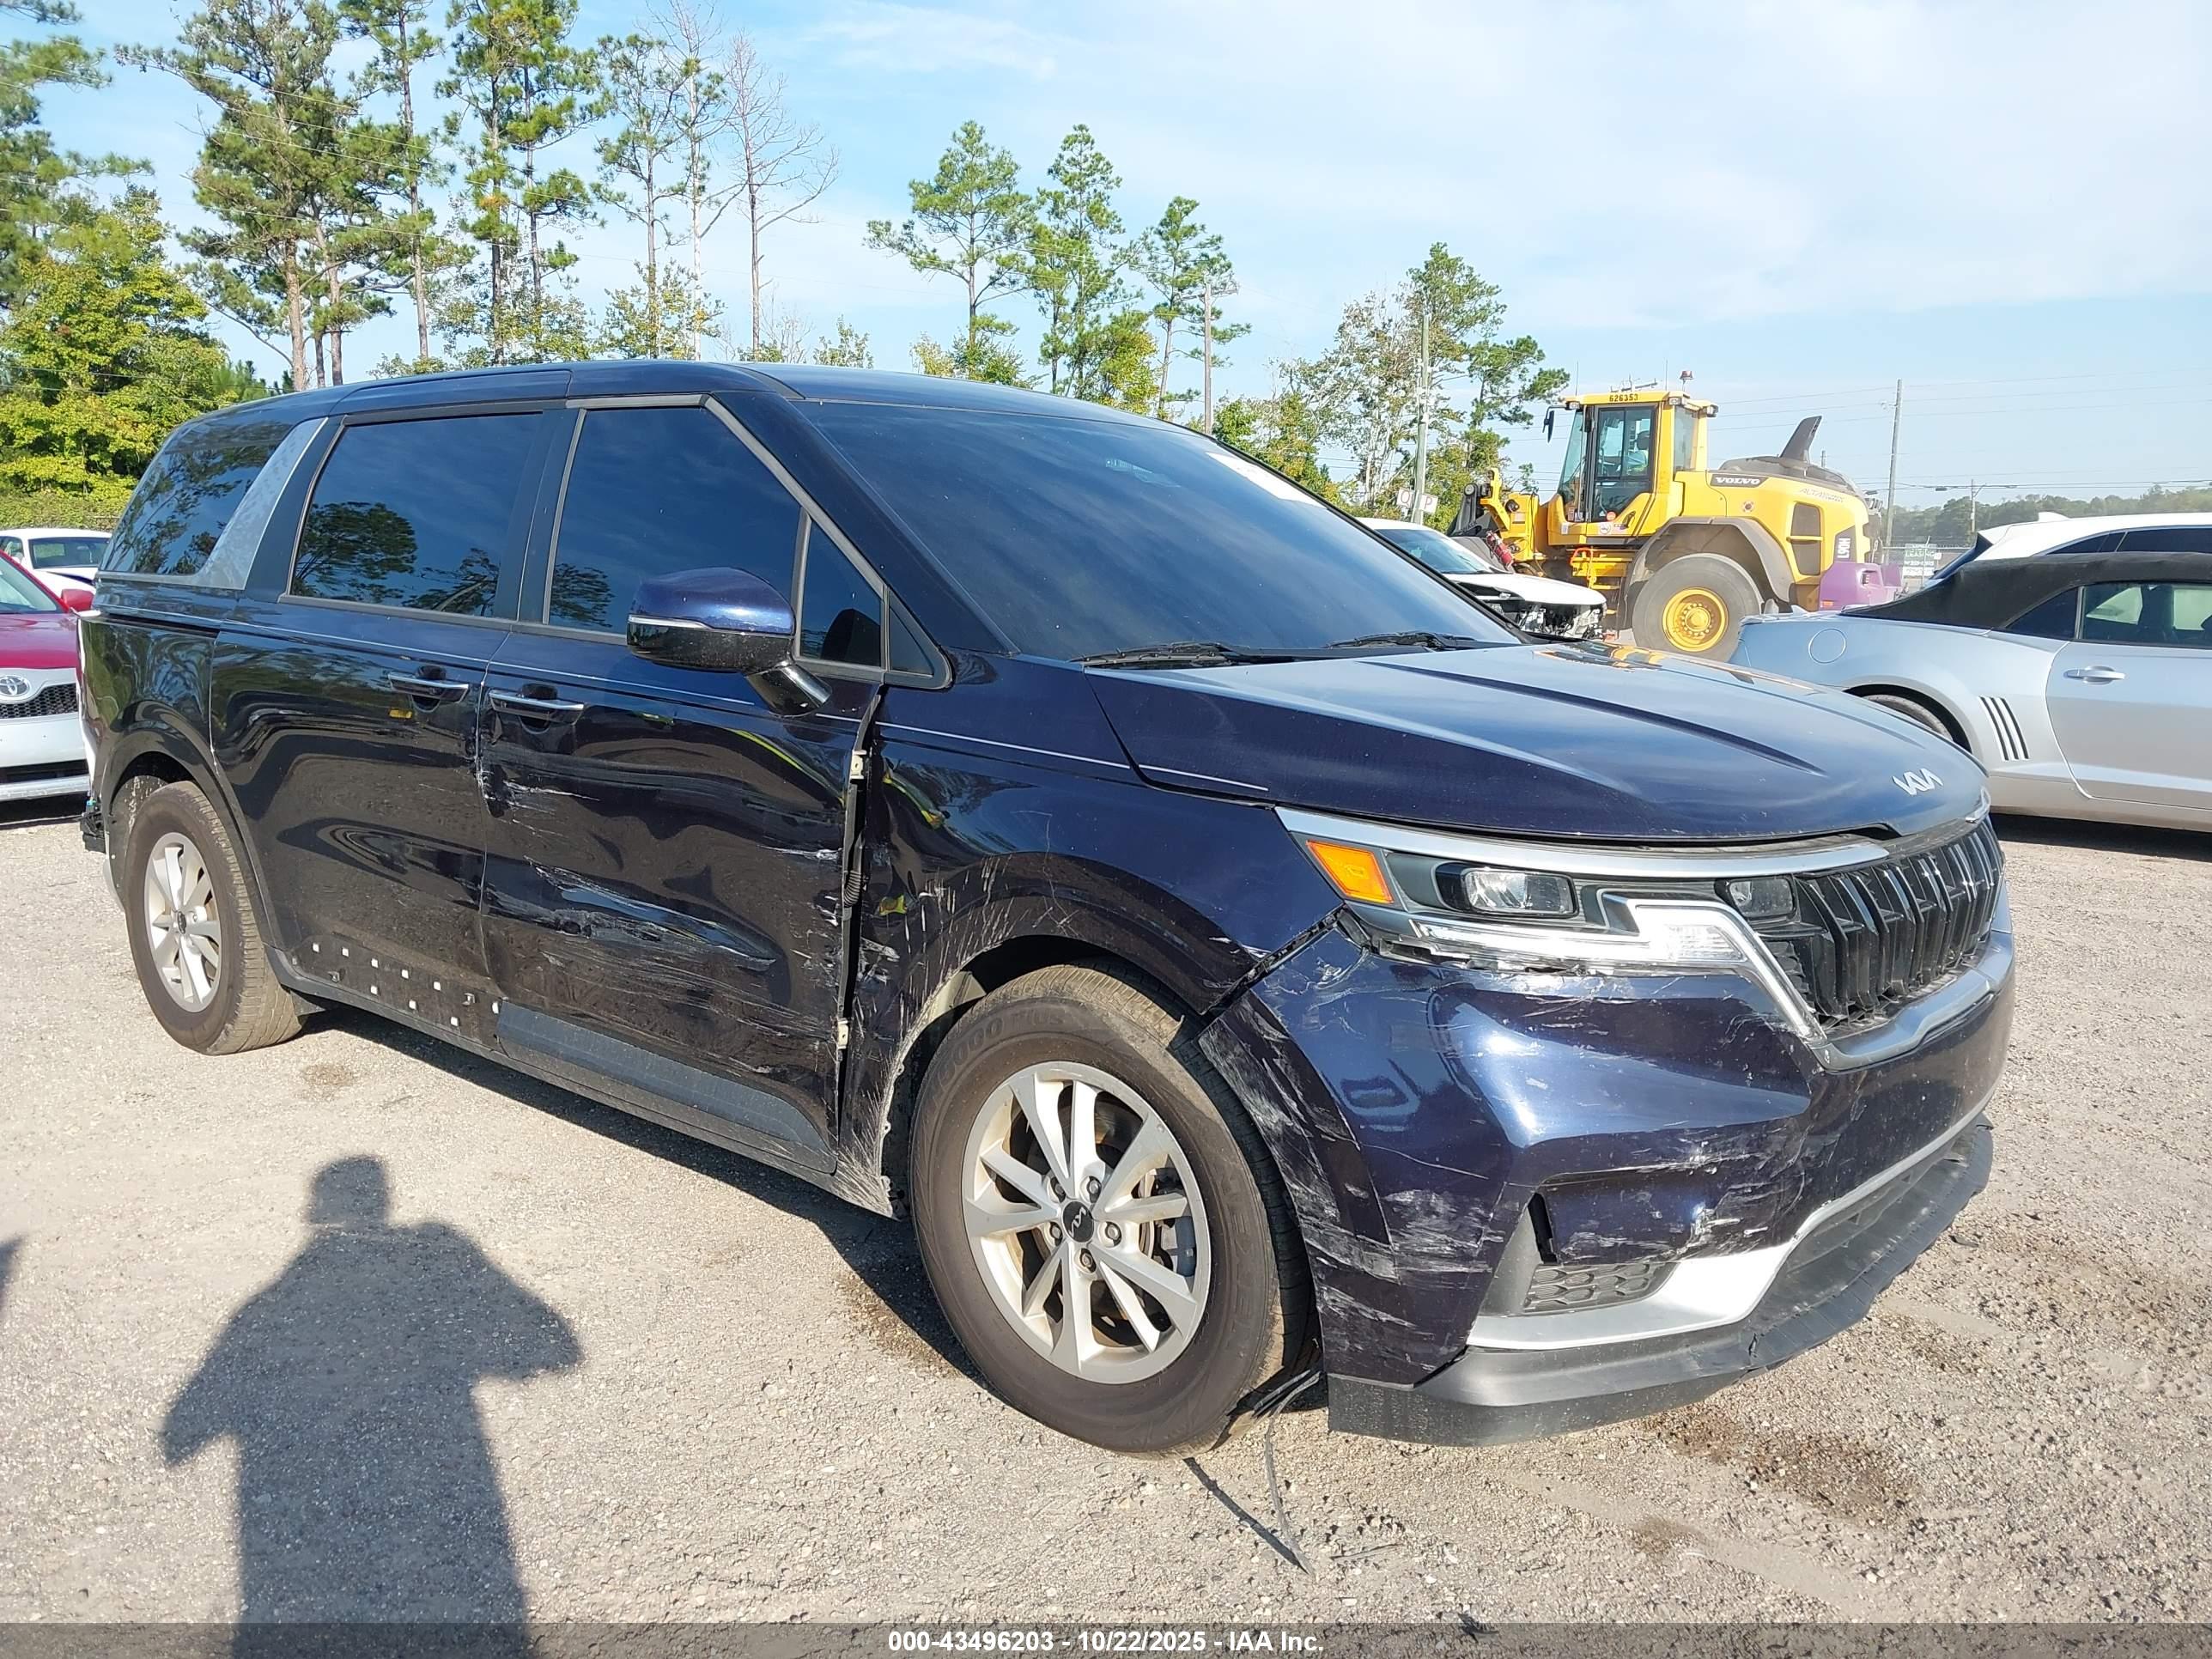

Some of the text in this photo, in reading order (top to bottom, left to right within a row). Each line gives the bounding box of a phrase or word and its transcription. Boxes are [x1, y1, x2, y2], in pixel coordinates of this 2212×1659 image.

[1609, 393, 1638, 402] 626353
[1716, 477, 1760, 485] VOLVO
[1424, 495, 1434, 509] P
[1837, 538, 1851, 558] L90H
[1892, 768, 1944, 796] KIA
